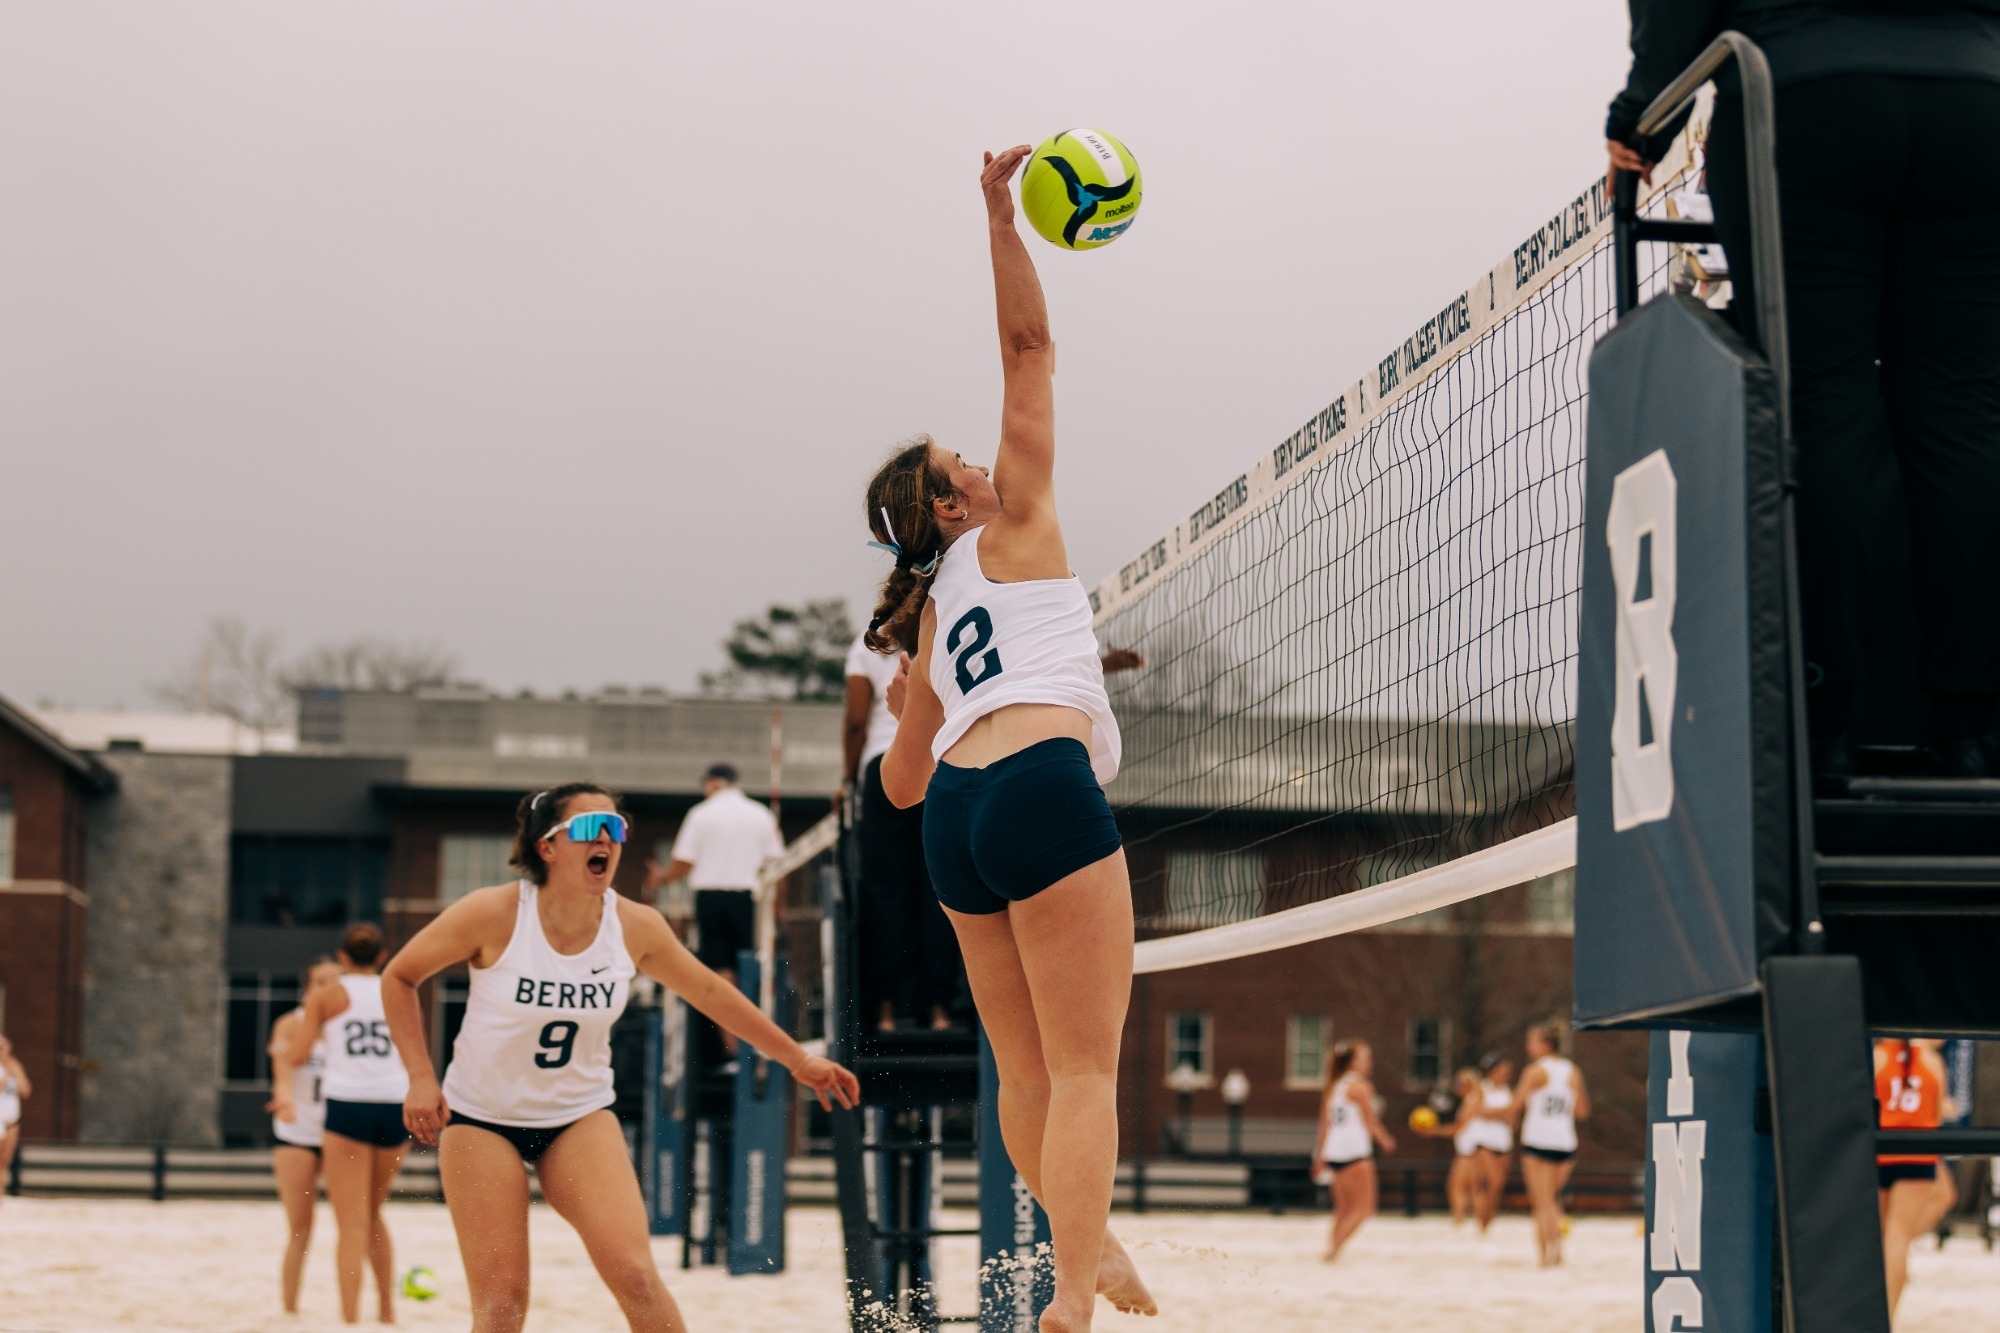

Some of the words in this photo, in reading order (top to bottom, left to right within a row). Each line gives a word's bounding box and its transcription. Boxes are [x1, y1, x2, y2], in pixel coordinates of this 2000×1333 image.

[1105, 202, 1134, 218] molten
[946, 606, 1003, 696] 2
[515, 977, 616, 1009] BERRY
[344, 1020, 392, 1057] 25
[535, 1020, 579, 1069] 9
